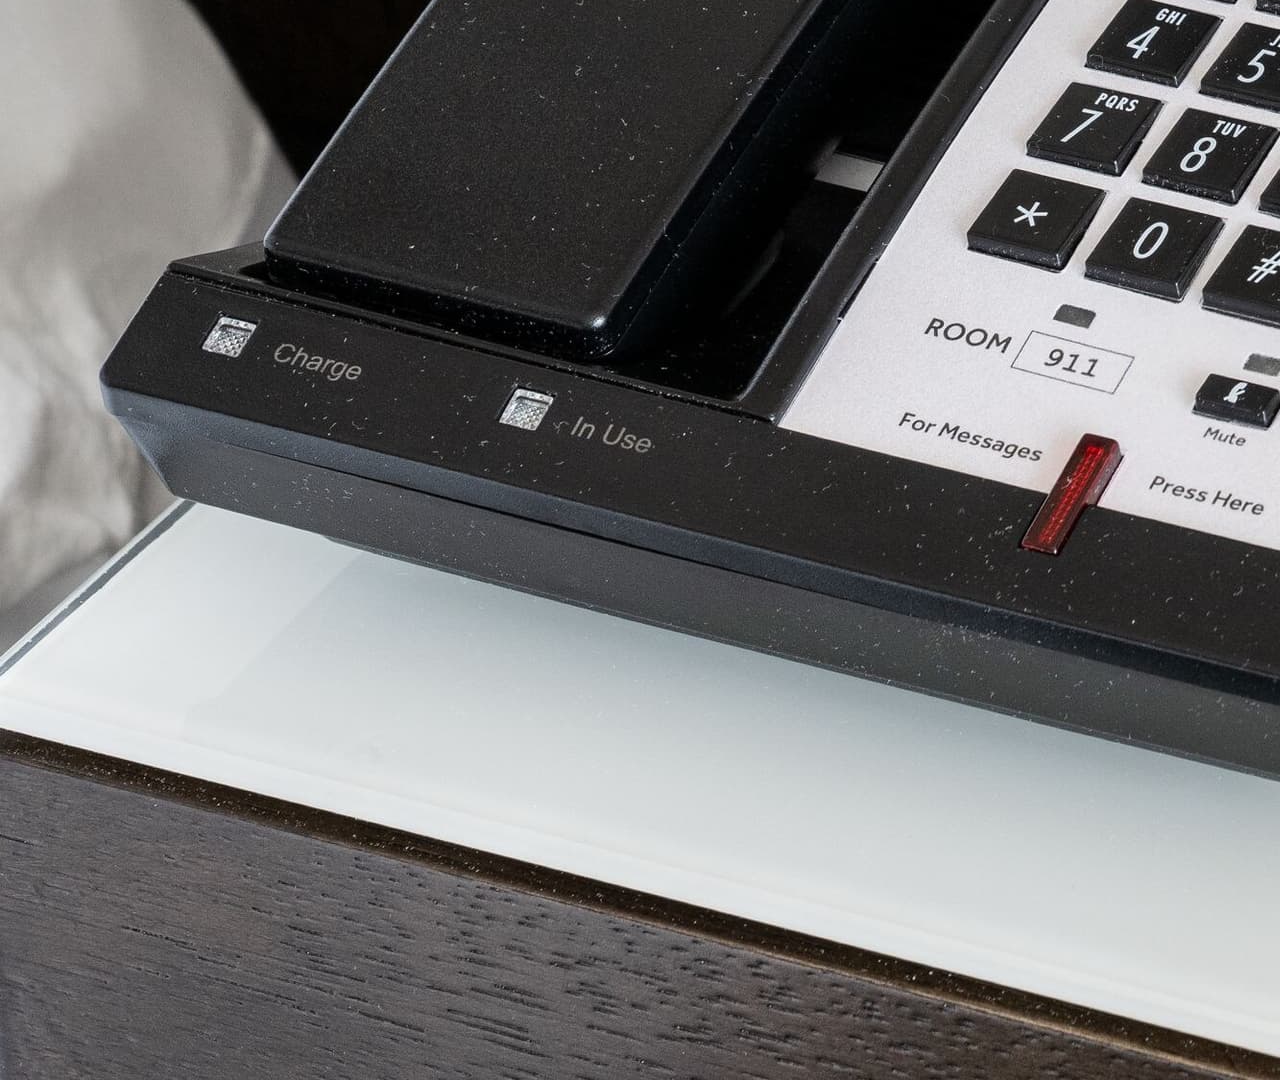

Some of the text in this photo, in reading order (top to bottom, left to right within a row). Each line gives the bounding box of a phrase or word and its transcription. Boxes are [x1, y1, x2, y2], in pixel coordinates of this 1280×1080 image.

[1155, 8, 1187, 26] GHI
[1126, 25, 1161, 60] 4
[1235, 49, 1277, 83] 5
[1094, 92, 1140, 113] PQRS
[1060, 108, 1103, 143] 7
[1212, 119, 1248, 138] TUV
[1179, 136, 1217, 173] 8
[1132, 221, 1169, 259] 0
[274, 343, 362, 382] Charge
[924, 318, 1099, 377] ROOM 911
[570, 416, 652, 453] In Use
[898, 411, 1043, 462] For Messages
[1203, 427, 1247, 447] Mute
[1149, 475, 1265, 517] Press Here
